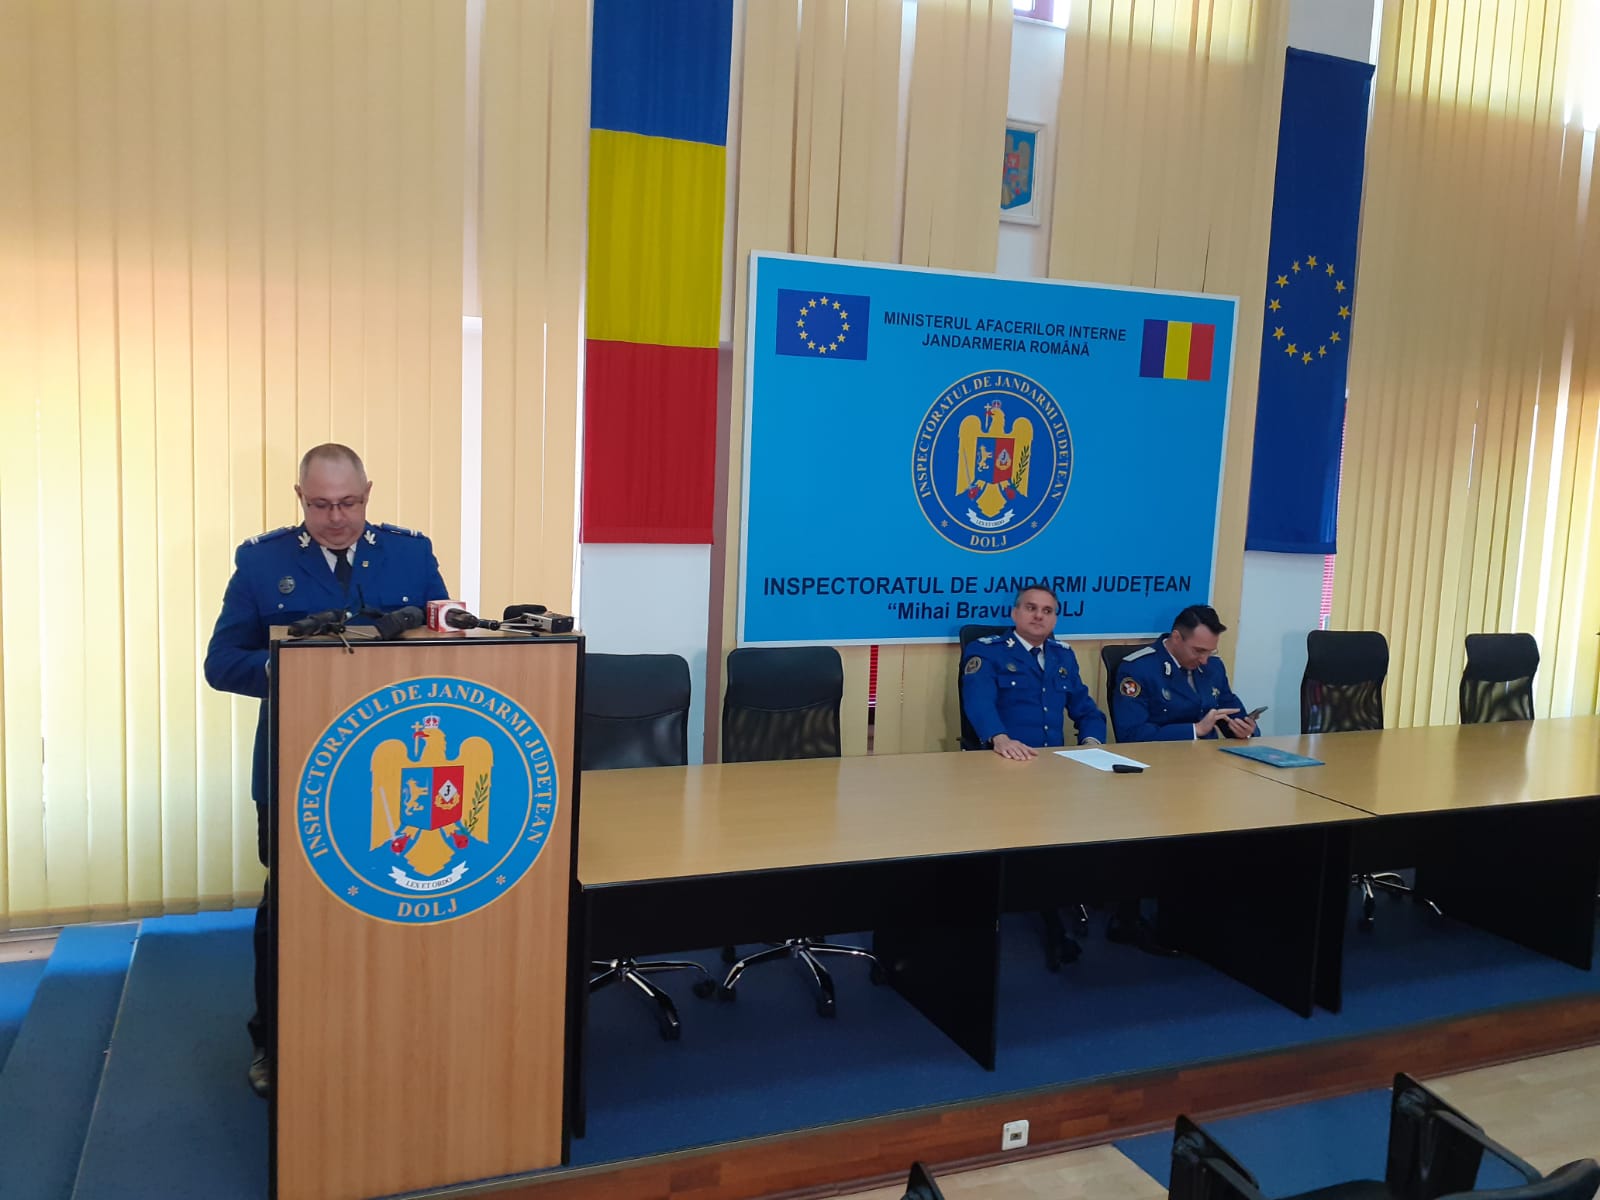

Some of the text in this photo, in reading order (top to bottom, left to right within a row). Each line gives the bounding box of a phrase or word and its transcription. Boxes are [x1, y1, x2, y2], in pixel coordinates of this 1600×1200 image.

[884, 311, 1127, 342] MINISTERUL AFACERILOR INTERNE
[922, 333, 1090, 357] JANDARMERIA ROMÂNĂ
[916, 386, 972, 498] INSPECTORATUL
[973, 376, 992, 390] DE
[995, 375, 1058, 420] JANDARMI
[970, 535, 1007, 548] DOLJ
[764, 575, 1191, 597] INSPECTORATUL DE JANDARMI JUDEȚEAN
[956, 601, 1012, 619] Bravu
[303, 697, 389, 858] INSPECTORATUL
[391, 684, 422, 706] DE
[427, 682, 532, 737] JANDARMI
[397, 898, 457, 918] DOLJ
